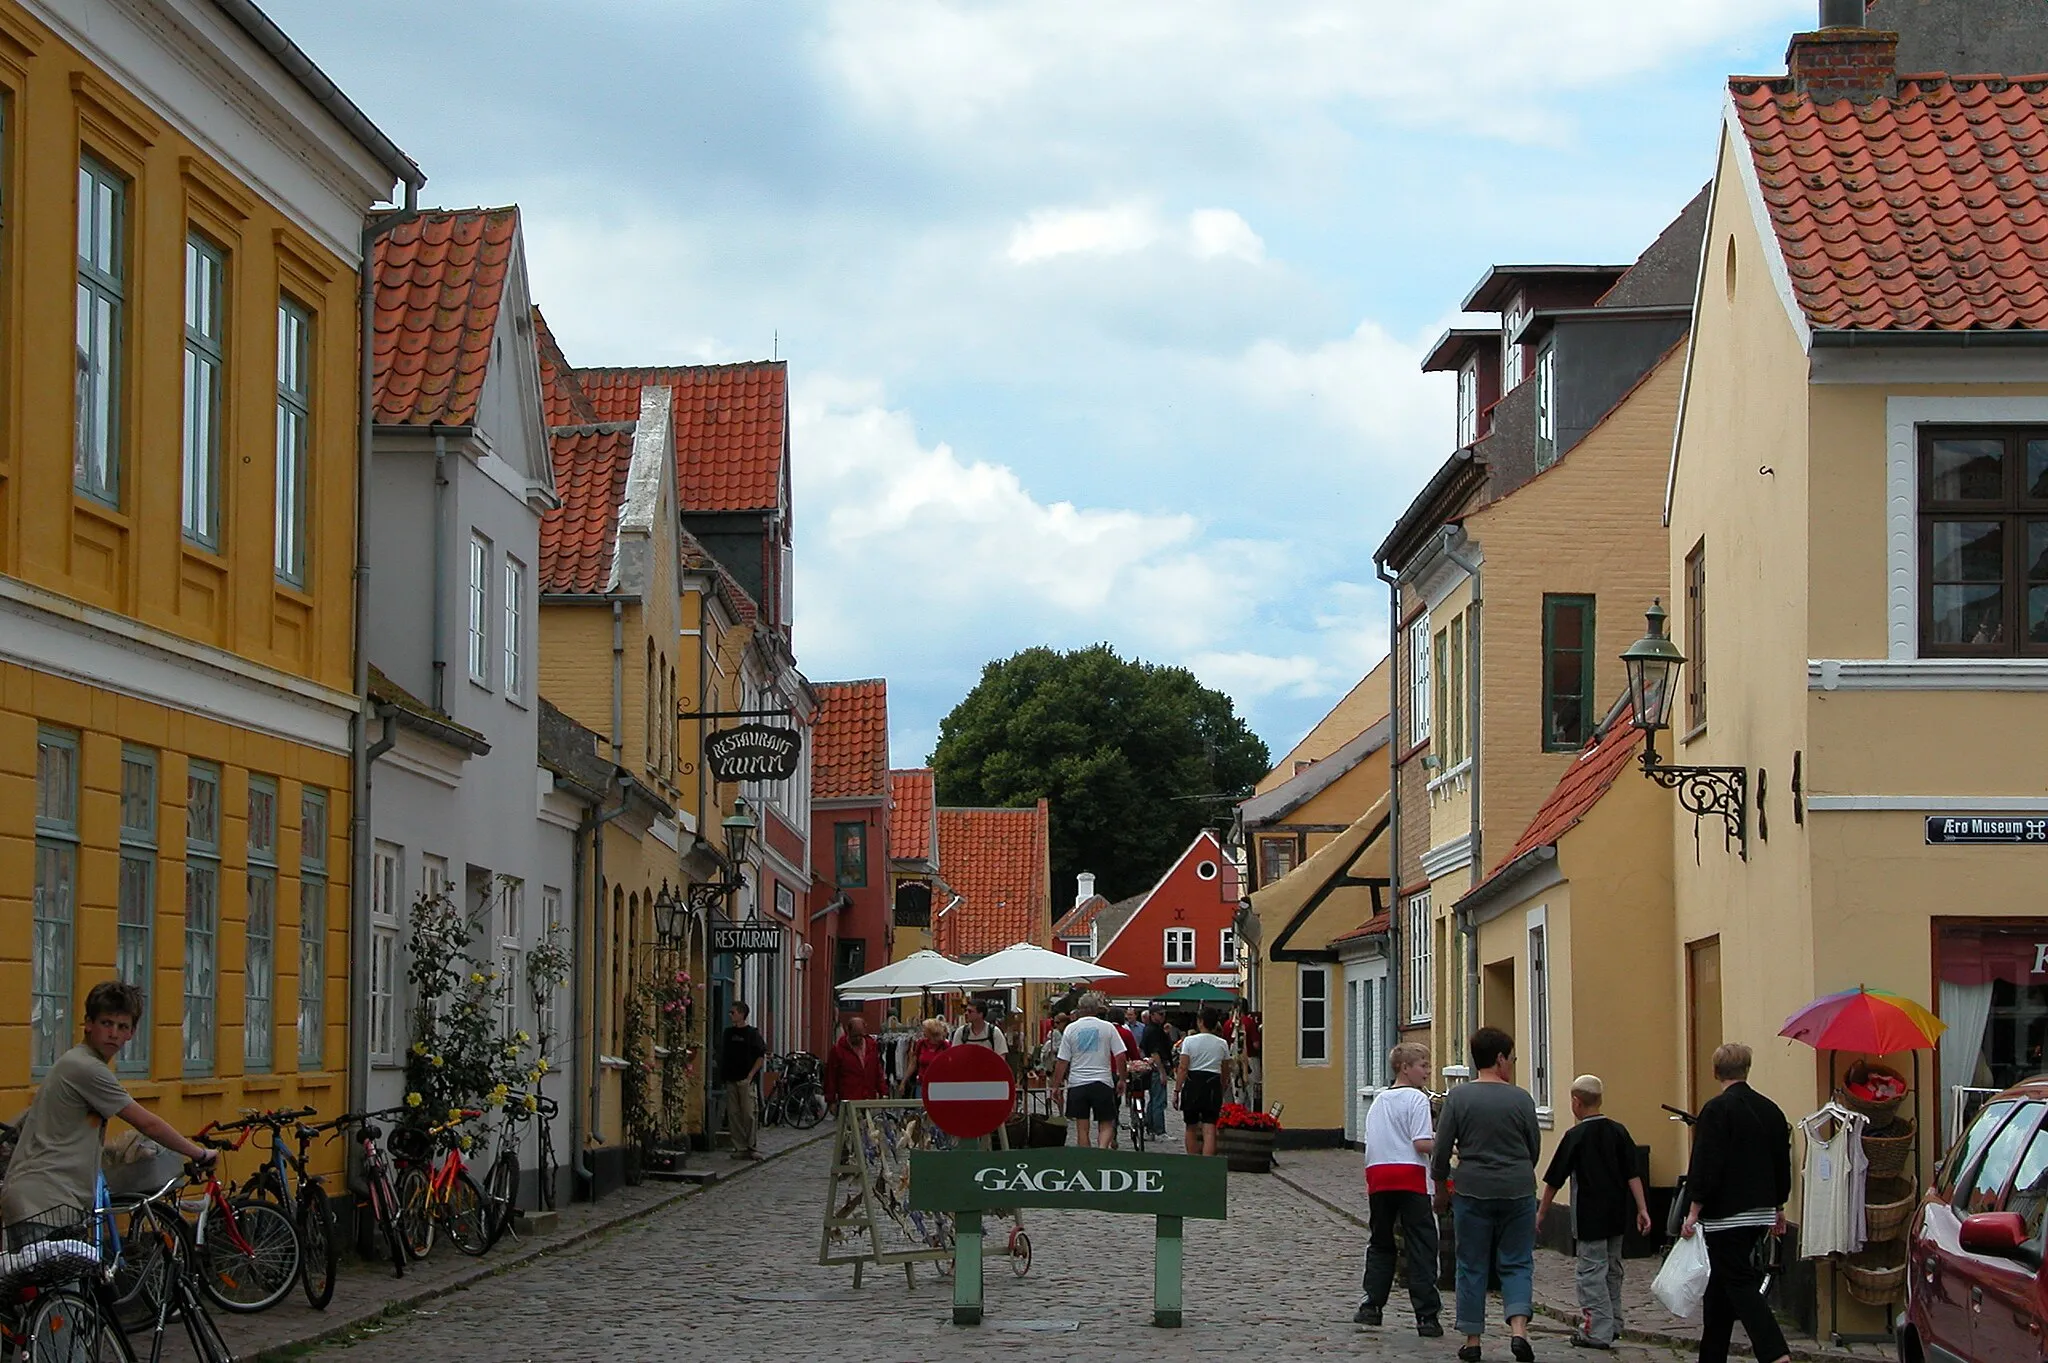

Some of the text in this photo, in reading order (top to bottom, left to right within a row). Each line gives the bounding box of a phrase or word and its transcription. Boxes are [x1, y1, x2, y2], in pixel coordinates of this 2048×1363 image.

[712, 731, 794, 759] RESTAURANT
[720, 755, 784, 775] MUMM
[1971, 819, 2023, 834] Museum
[715, 930, 780, 948] RESTAURANT
[974, 1162, 1165, 1193] GÅGADE
